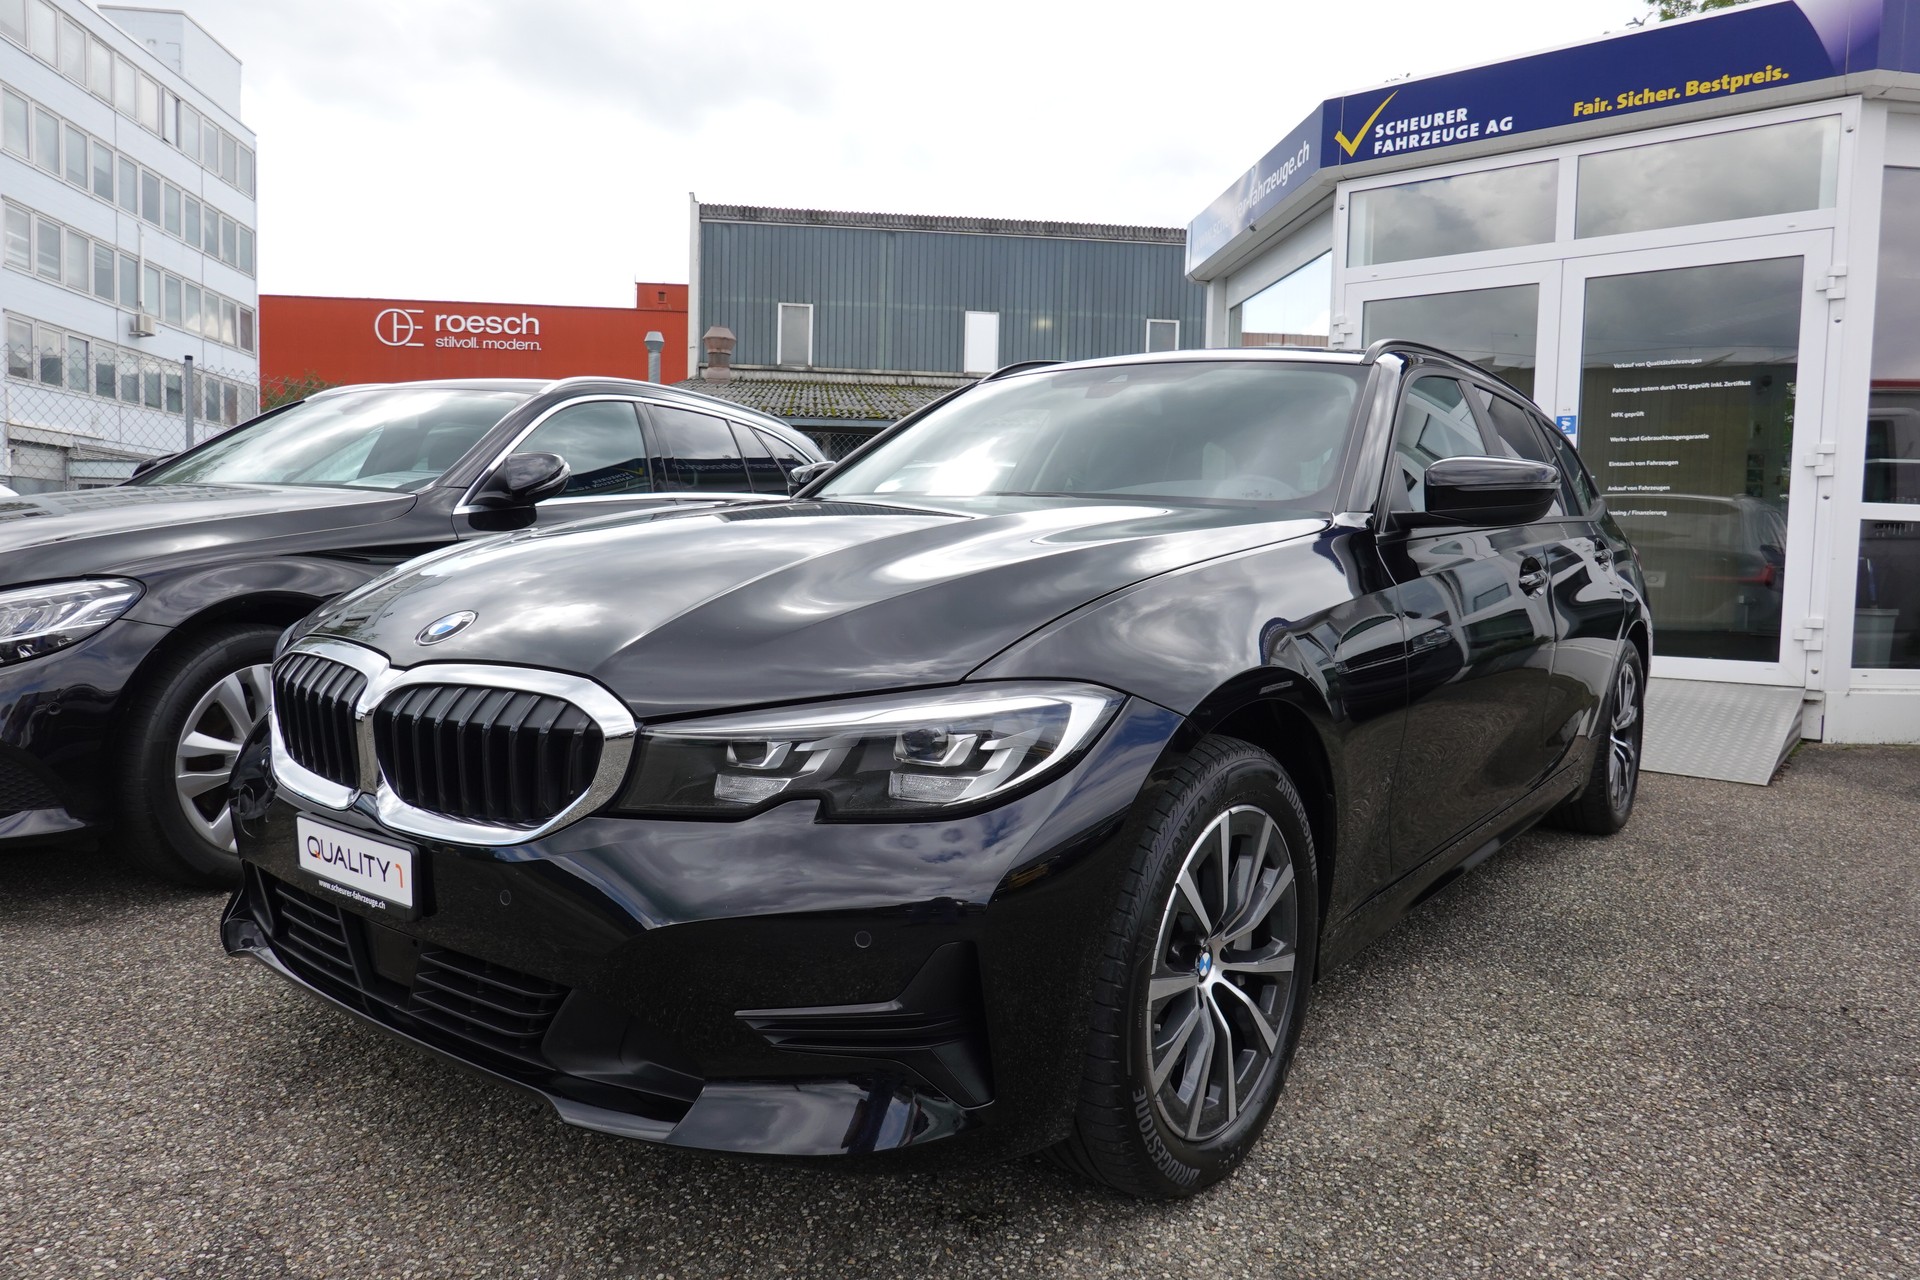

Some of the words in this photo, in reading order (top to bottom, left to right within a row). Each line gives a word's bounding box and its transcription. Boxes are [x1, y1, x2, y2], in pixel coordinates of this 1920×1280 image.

[1573, 97, 1612, 117] Fair.
[1616, 87, 1681, 109] Sicher.
[1685, 65, 1790, 97] Bestpreis.
[1373, 122, 1480, 155] FAHRZEUGE
[1485, 116, 1513, 135] AG
[1375, 107, 1468, 139] SCHEURER
[1193, 140, 1310, 252] www.schrer-fahrzeuge.ch
[434, 313, 540, 335] roesch
[435, 336, 479, 349] stilvoll.
[482, 338, 542, 351] modern.
[1688, 382, 1709, 390] geprüft
[1640, 433, 1710, 441] Gebrauchtwagengarantie
[1632, 509, 1667, 517] Finanzierung
[1275, 773, 1318, 882] BRIDGESTONE
[307, 835, 391, 883] QUALITY
[318, 879, 386, 910] www.scheurer-fahrzeuge.ch
[1132, 1086, 1201, 1186] BRIDGESTONE
